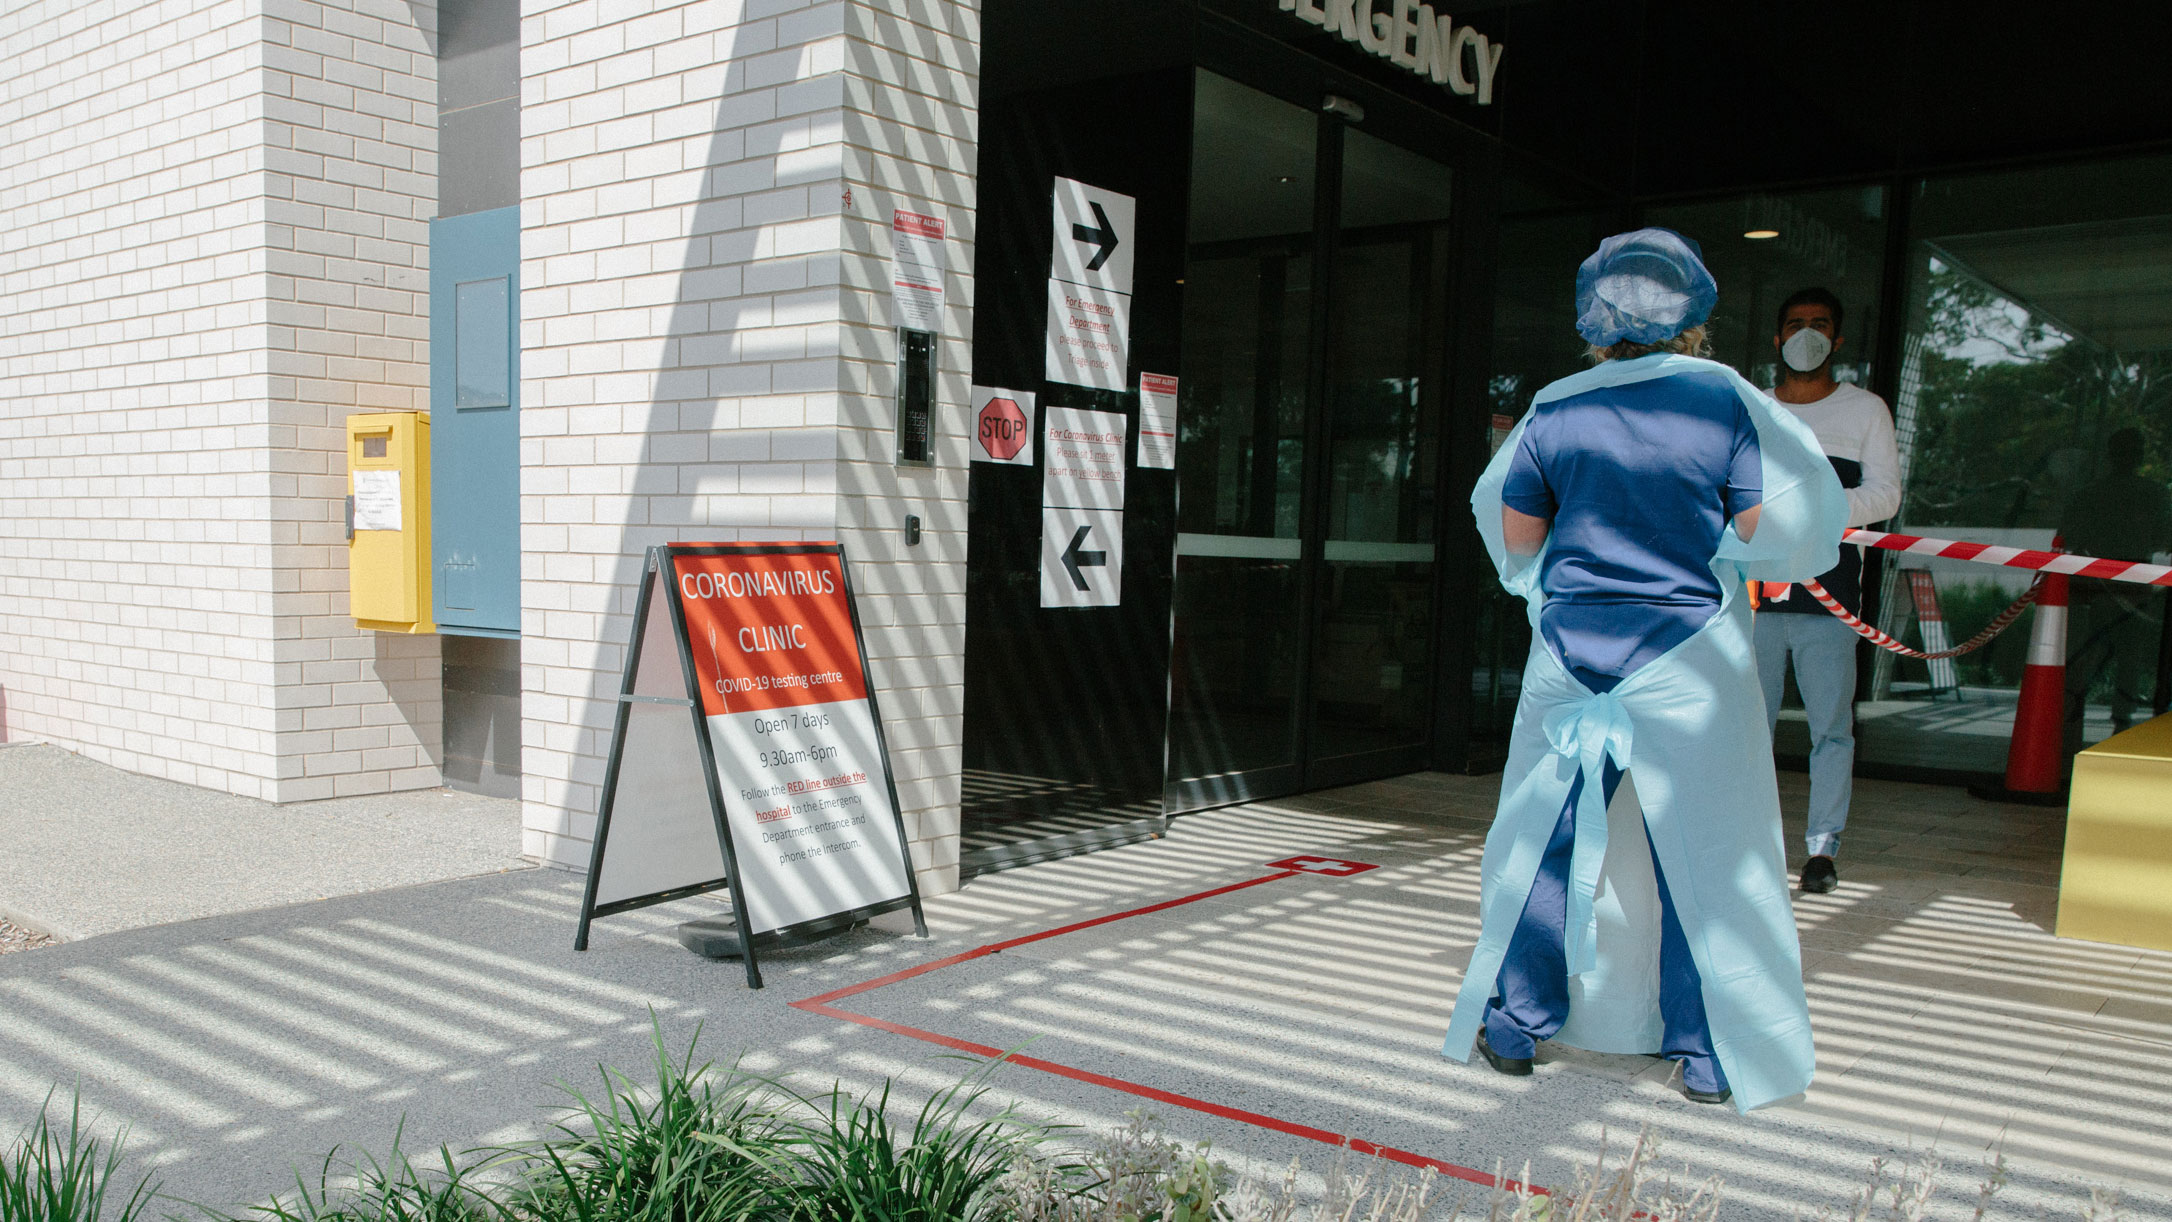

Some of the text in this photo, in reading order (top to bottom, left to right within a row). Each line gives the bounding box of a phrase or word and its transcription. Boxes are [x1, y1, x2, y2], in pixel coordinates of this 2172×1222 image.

[1278, 0, 1503, 105] RGENCY
[895, 212, 944, 229] PATIENT ALERT
[1065, 295, 1115, 316] For Emergency
[1069, 315, 1110, 334] Department
[1060, 335, 1119, 353] please proceed to
[1068, 353, 1110, 370] Triage inside
[1142, 375, 1161, 385] PATIENT
[982, 416, 1024, 440] STOP
[1050, 428, 1123, 445] For Coronavirus Clinic
[1057, 447, 1078, 458] Please
[1079, 450, 1088, 458] sit
[1094, 451, 1116, 463] meter
[1048, 467, 1121, 481] apart on yellow bench
[681, 569, 835, 599] CORONAVIRUS
[738, 623, 807, 653] CLINIC
[715, 670, 843, 694] COVID-19 testing centre
[754, 712, 830, 736] Open 7 days
[759, 744, 838, 768] 9.30am-6pm
[741, 771, 867, 801] Follow the RED line outside the
[755, 793, 862, 825] hospital to the Emergency
[762, 813, 866, 844] Department entrance and
[779, 838, 862, 866] phone the Intercom.
